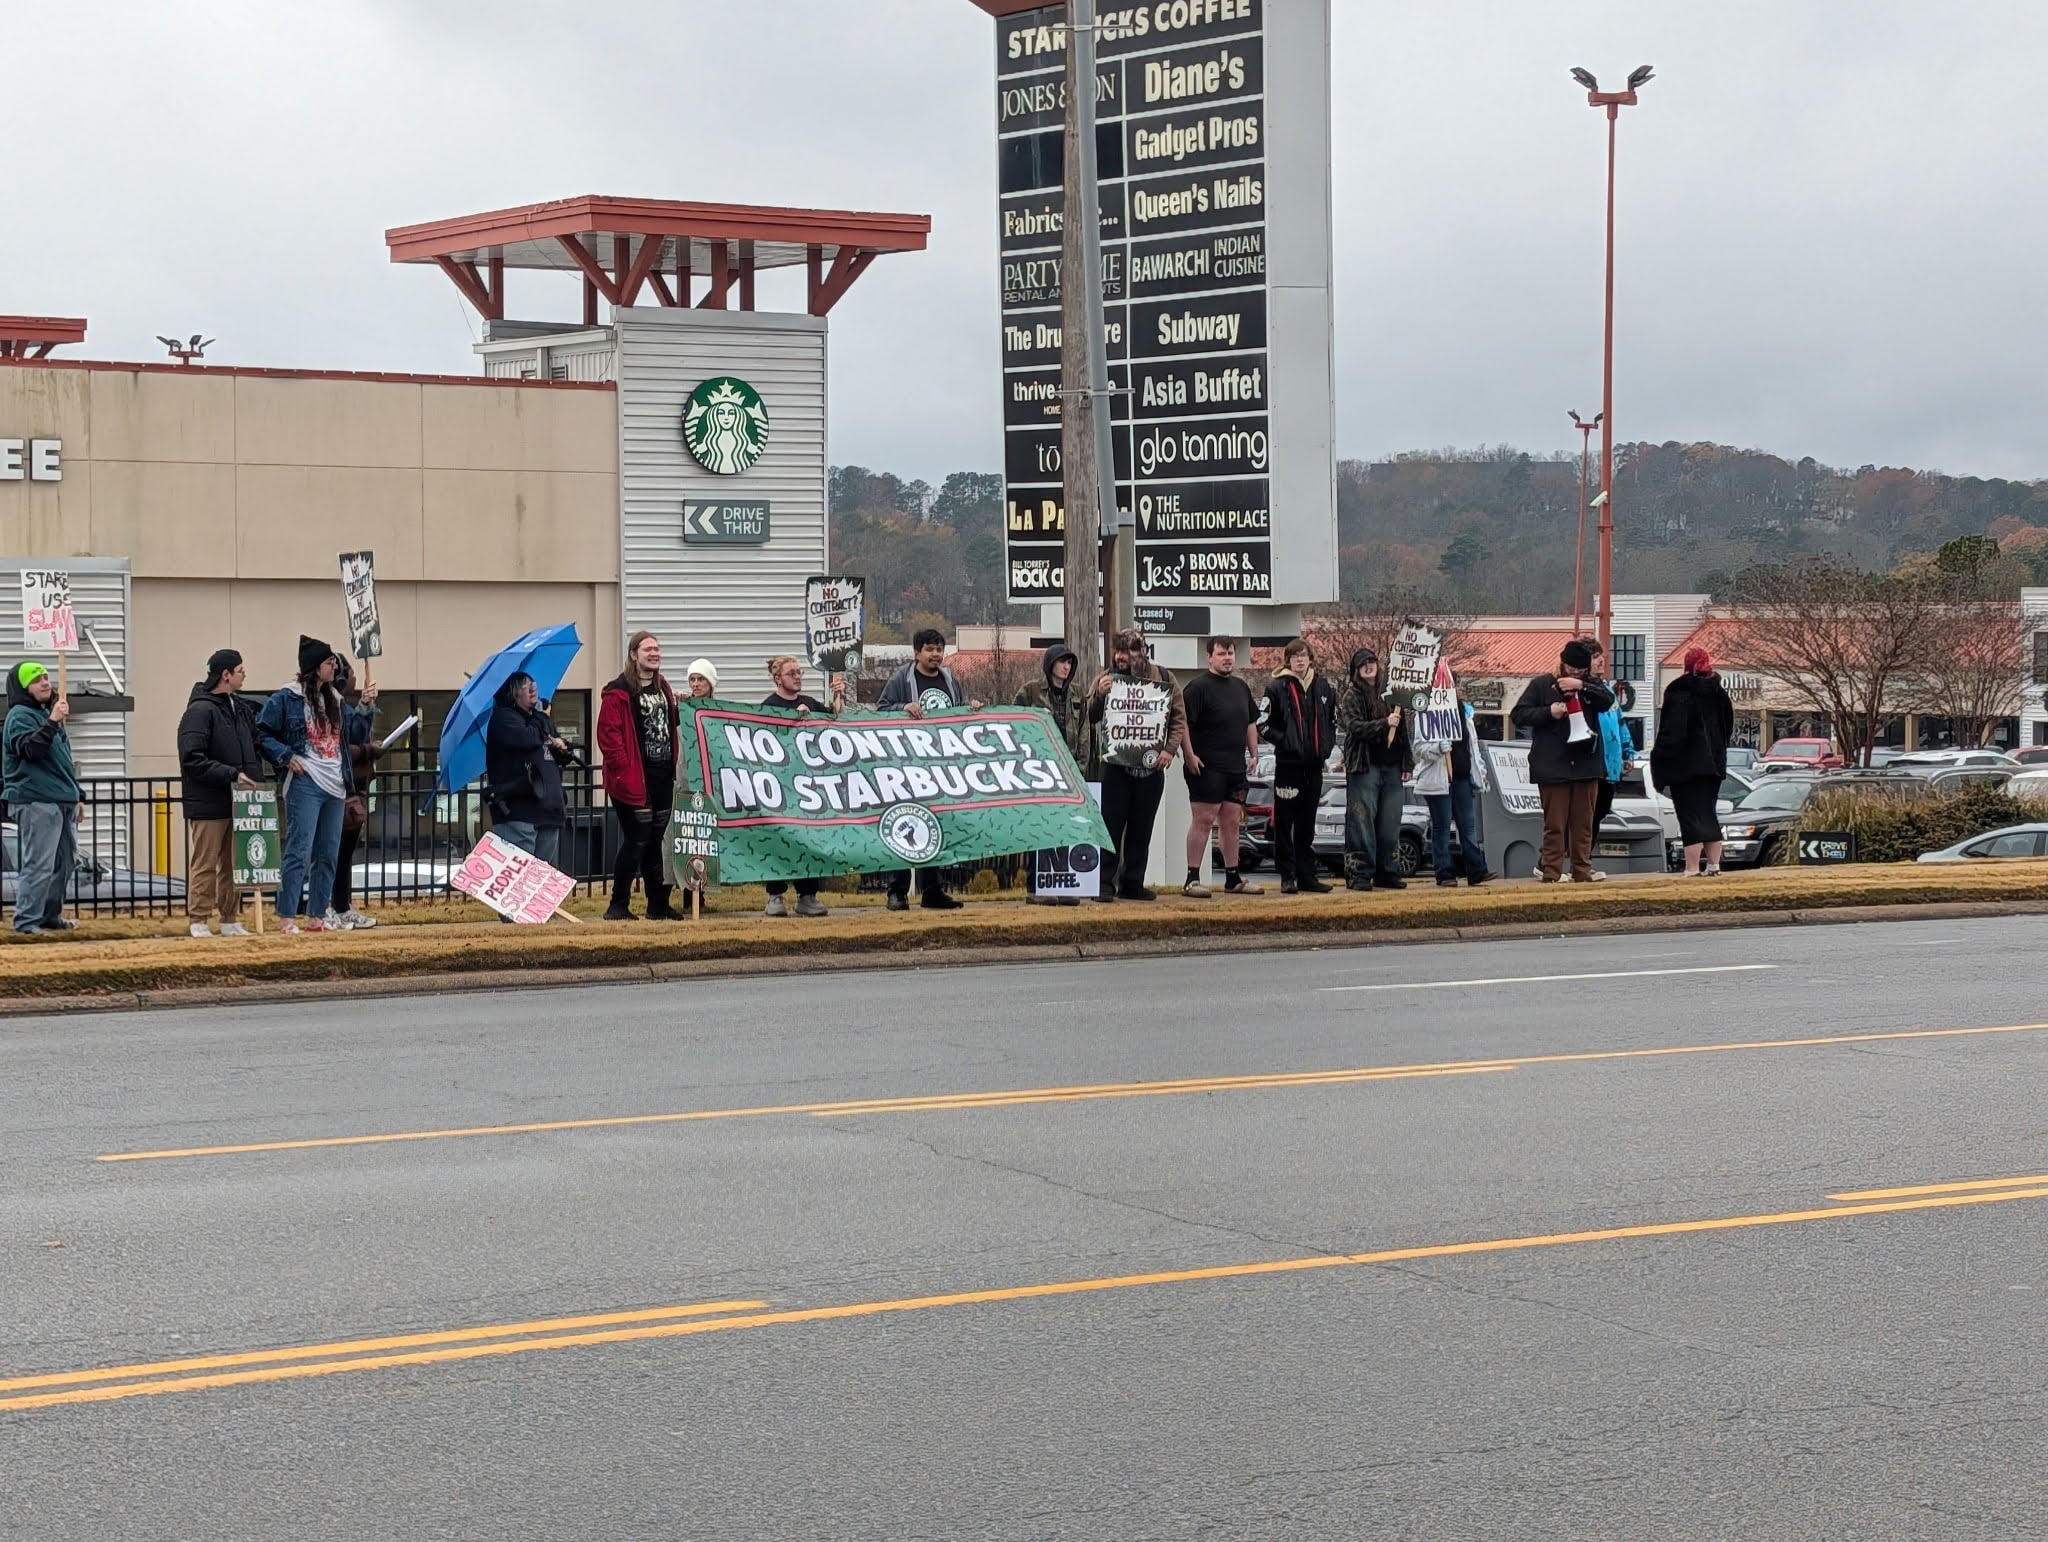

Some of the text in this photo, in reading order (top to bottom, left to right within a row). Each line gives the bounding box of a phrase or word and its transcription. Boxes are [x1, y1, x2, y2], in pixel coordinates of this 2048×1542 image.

[1154, 0, 1251, 32] COFFEE
[1144, 49, 1245, 103] Diane's
[1002, 83, 1055, 122] JONES
[1135, 116, 1258, 161] Gadget Pros
[1134, 183, 1209, 223] Queen's
[1213, 175, 1262, 210] Nails
[1214, 234, 1261, 257] INDIAN
[1131, 248, 1210, 283] BAWARCHI
[1214, 254, 1265, 278] CUISINE
[1004, 290, 1046, 303] RENTAL
[1157, 310, 1241, 346] Subway
[1004, 325, 1033, 352] The
[1013, 381, 1056, 402] thrive
[1142, 374, 1188, 407] Asia
[1194, 367, 1262, 404] Buffet
[1140, 424, 1267, 475] glo tanning
[722, 507, 765, 521] DRIVE
[1155, 495, 1181, 513] THE
[722, 521, 762, 535] THRU
[1156, 509, 1268, 532] NUTRITION PLACE
[1189, 552, 1255, 571] BROWS &
[1012, 568, 1050, 588] ROCK
[1190, 573, 1270, 591] BEAUTY BAR
[823, 587, 840, 600] NO
[810, 594, 858, 615] CONTRACT?
[1138, 608, 1174, 621] Leased by
[825, 616, 841, 629] NO
[1143, 620, 1167, 632] Group
[814, 621, 857, 647] COFFEE!
[1406, 630, 1418, 643] NO
[1394, 641, 1437, 657] CONTRACT?
[1401, 656, 1415, 669] NO
[1391, 667, 1430, 684] COFFEE!
[1127, 687, 1145, 699] NO
[1110, 698, 1166, 712] CONTRACT?
[1126, 714, 1145, 726] NO
[1420, 708, 1462, 741] UNION
[1111, 722, 1161, 741] COFFEE!
[723, 724, 786, 764] NO
[794, 722, 1033, 768] CONTRACT,
[719, 758, 1070, 811] NO STARBUCKS!
[674, 809, 718, 828] BARISTAS
[885, 806, 930, 827] STARBUCKS
[681, 825, 713, 839] ON ULP
[674, 837, 719, 857] STRIKE!
[451, 836, 507, 889] HOT
[485, 855, 528, 901] PEOPLE
[1037, 873, 1081, 889] COFFEE.
